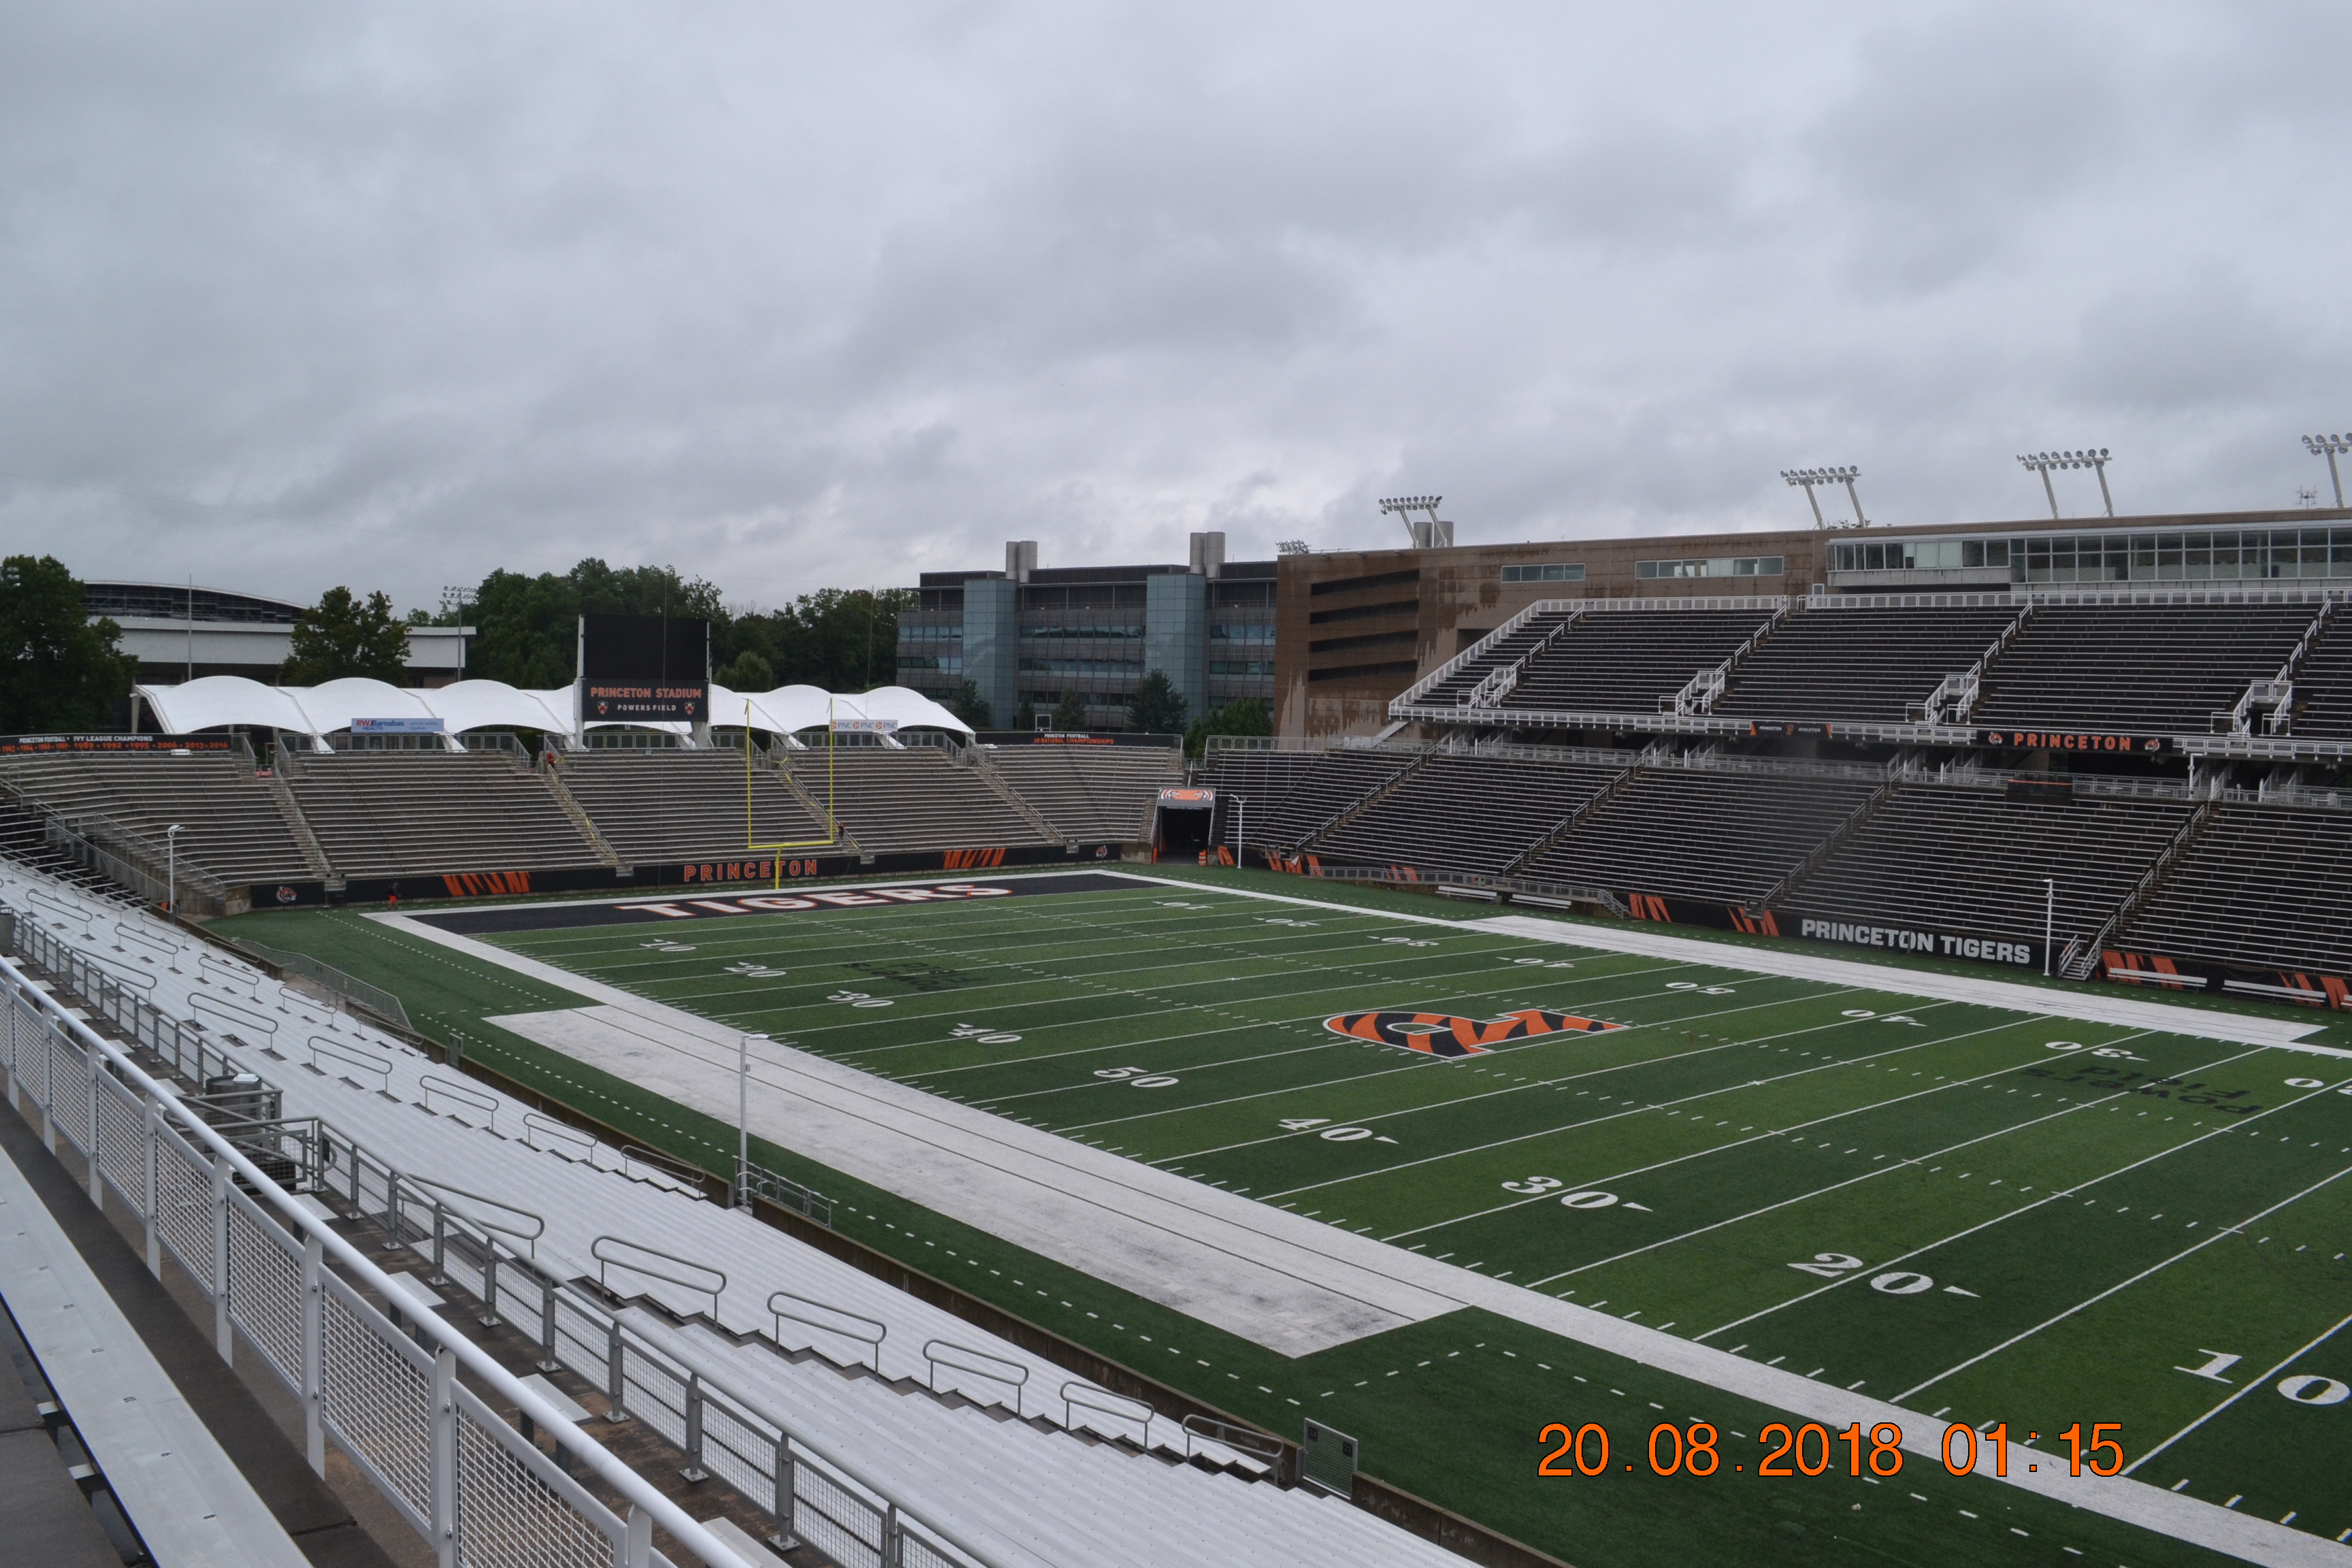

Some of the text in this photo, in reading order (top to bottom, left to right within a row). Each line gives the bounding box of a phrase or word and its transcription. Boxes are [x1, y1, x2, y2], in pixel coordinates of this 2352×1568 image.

[590, 687, 702, 698] PRINCETON STADIUM
[2014, 733, 2131, 751] PRINCETON
[684, 860, 817, 882] PRINCETON
[612, 885, 1013, 917] TIGERS
[1802, 919, 2030, 964] PRINCETON TIGERS
[723, 965, 787, 977] 20
[827, 993, 894, 1007] 30
[949, 1028, 1022, 1043] 40
[1094, 1066, 1179, 1088] 50
[1277, 1119, 1373, 1141] 40
[1501, 1176, 1618, 1209] 30
[1786, 1253, 1933, 1294] 20
[2173, 1348, 2351, 1405] 10
